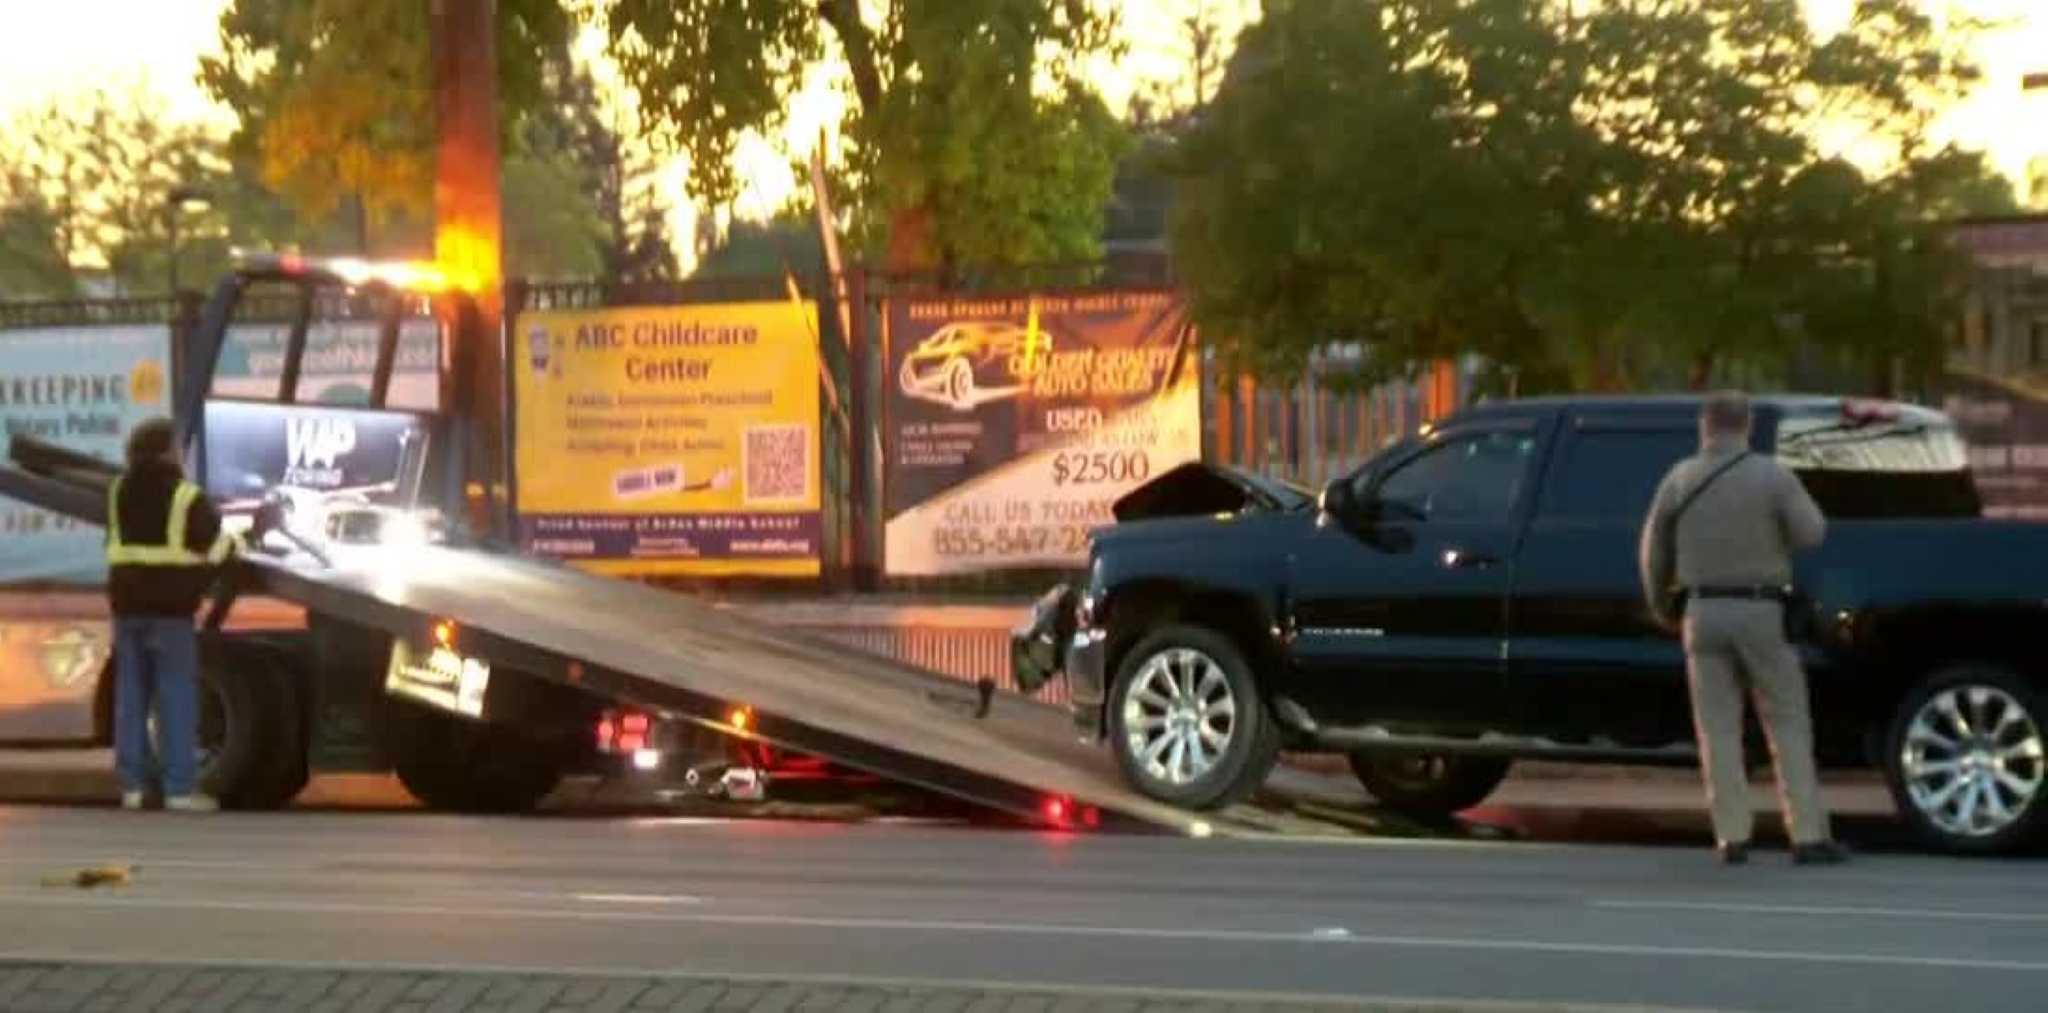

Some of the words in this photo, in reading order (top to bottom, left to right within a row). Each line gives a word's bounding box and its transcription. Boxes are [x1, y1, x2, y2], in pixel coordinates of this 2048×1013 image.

[632, 319, 758, 346] Childcare
[624, 356, 711, 381] Center
[1052, 451, 1151, 486] $2500
